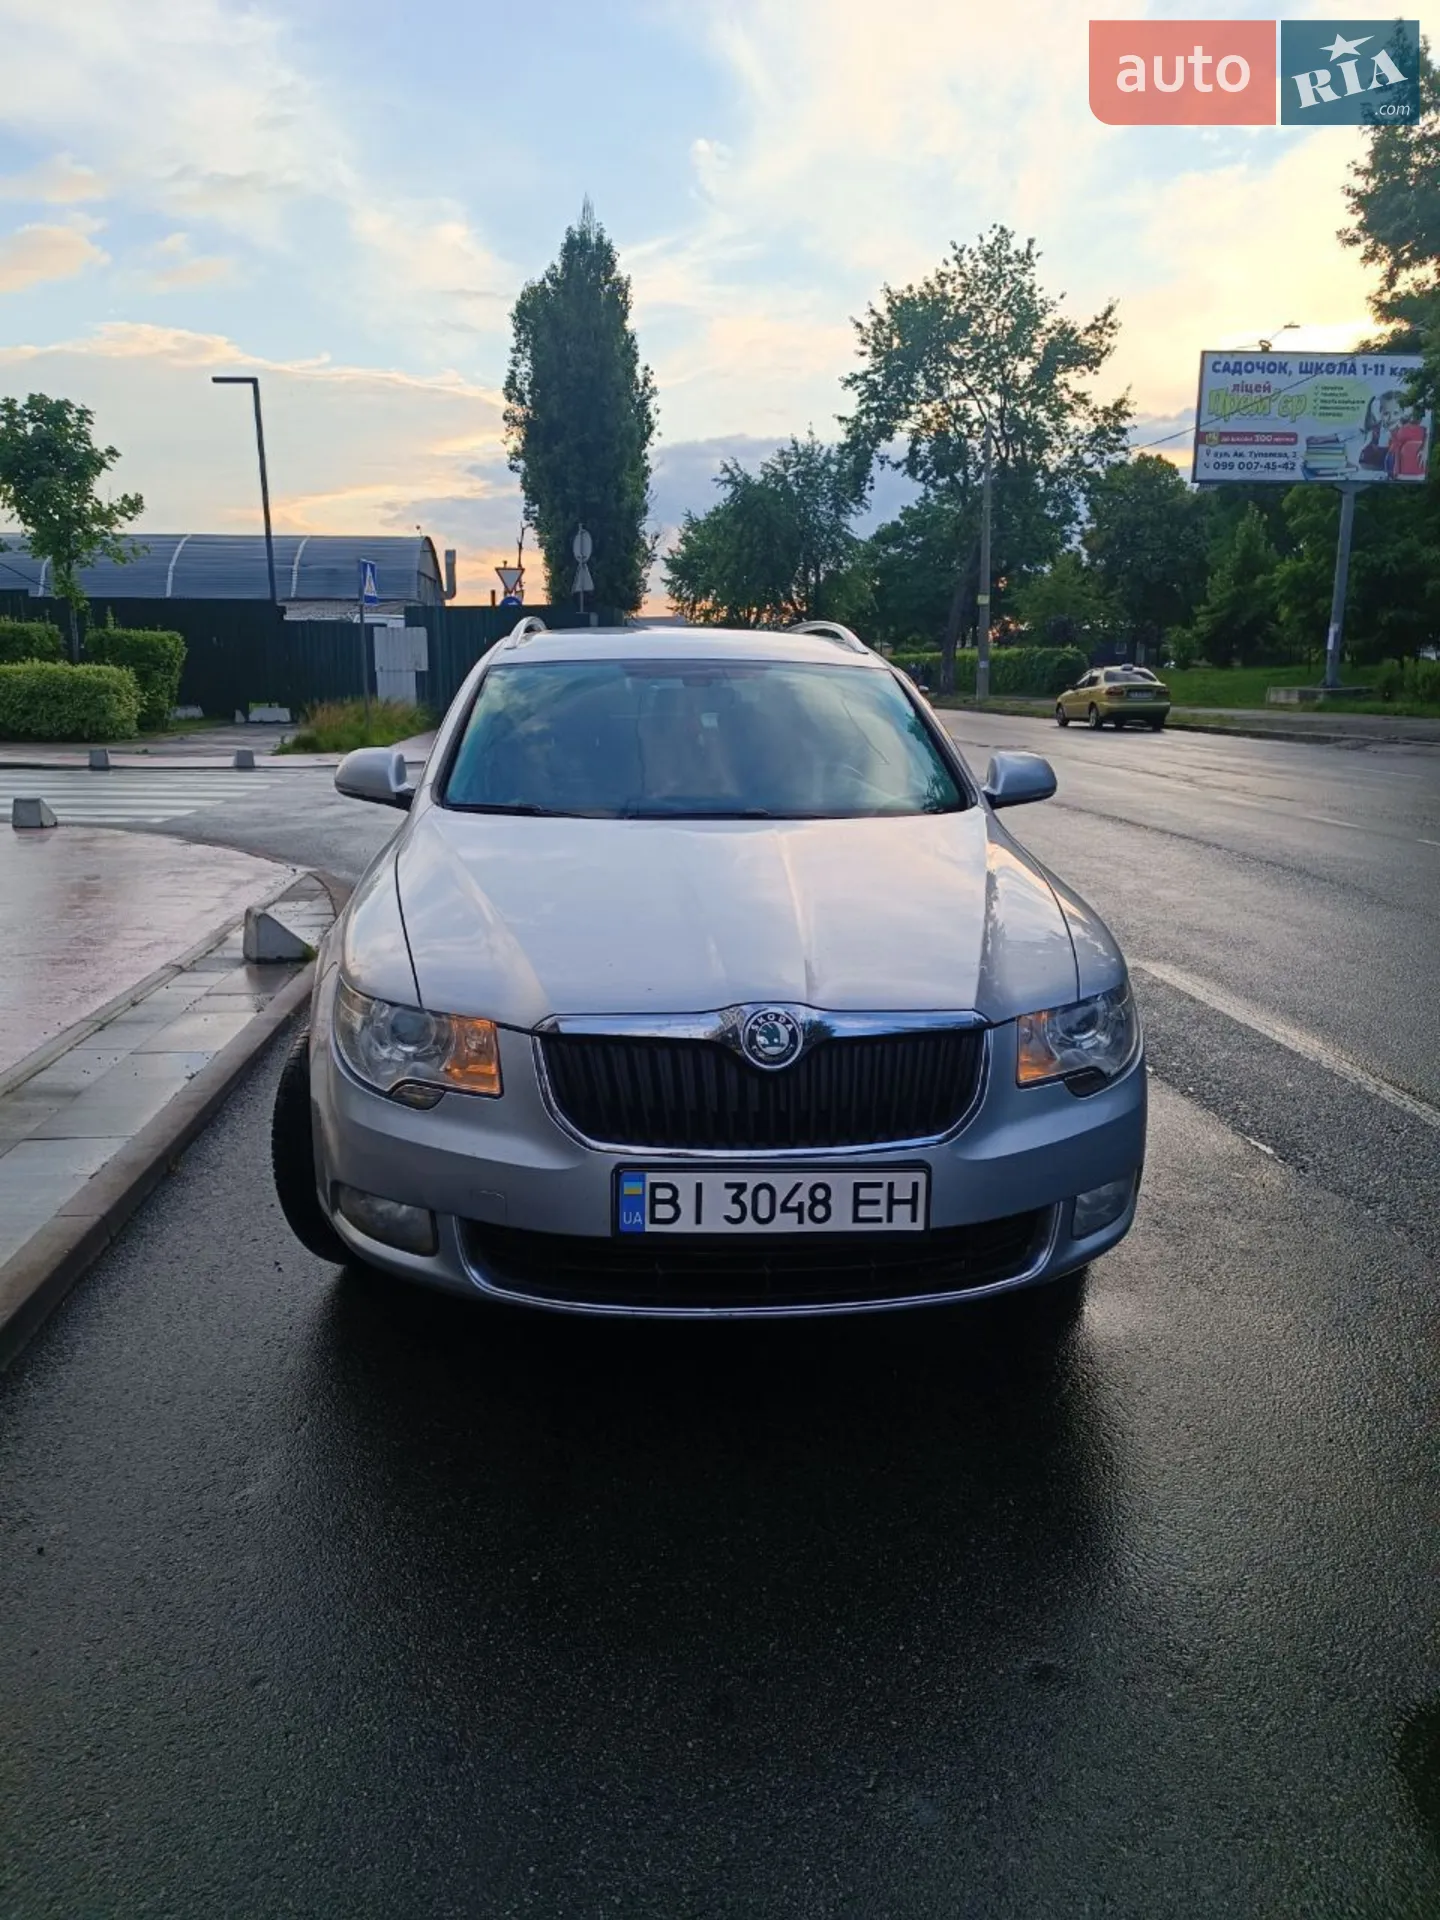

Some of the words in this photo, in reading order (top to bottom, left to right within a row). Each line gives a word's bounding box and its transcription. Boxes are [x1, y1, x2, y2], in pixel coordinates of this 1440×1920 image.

[1211, 360, 1293, 377] САДОЧОК,
[1298, 361, 1357, 376] ШКОЛА
[1362, 363, 1386, 376] 1-11
[1231, 380, 1272, 394] ліцей
[1213, 461, 1235, 470] 099
[1237, 461, 1297, 471] 007-45-42
[648, 1181, 703, 1226] BI
[723, 1182, 833, 1226] 3048
[852, 1181, 919, 1224] EH
[623, 1211, 643, 1226] UA
